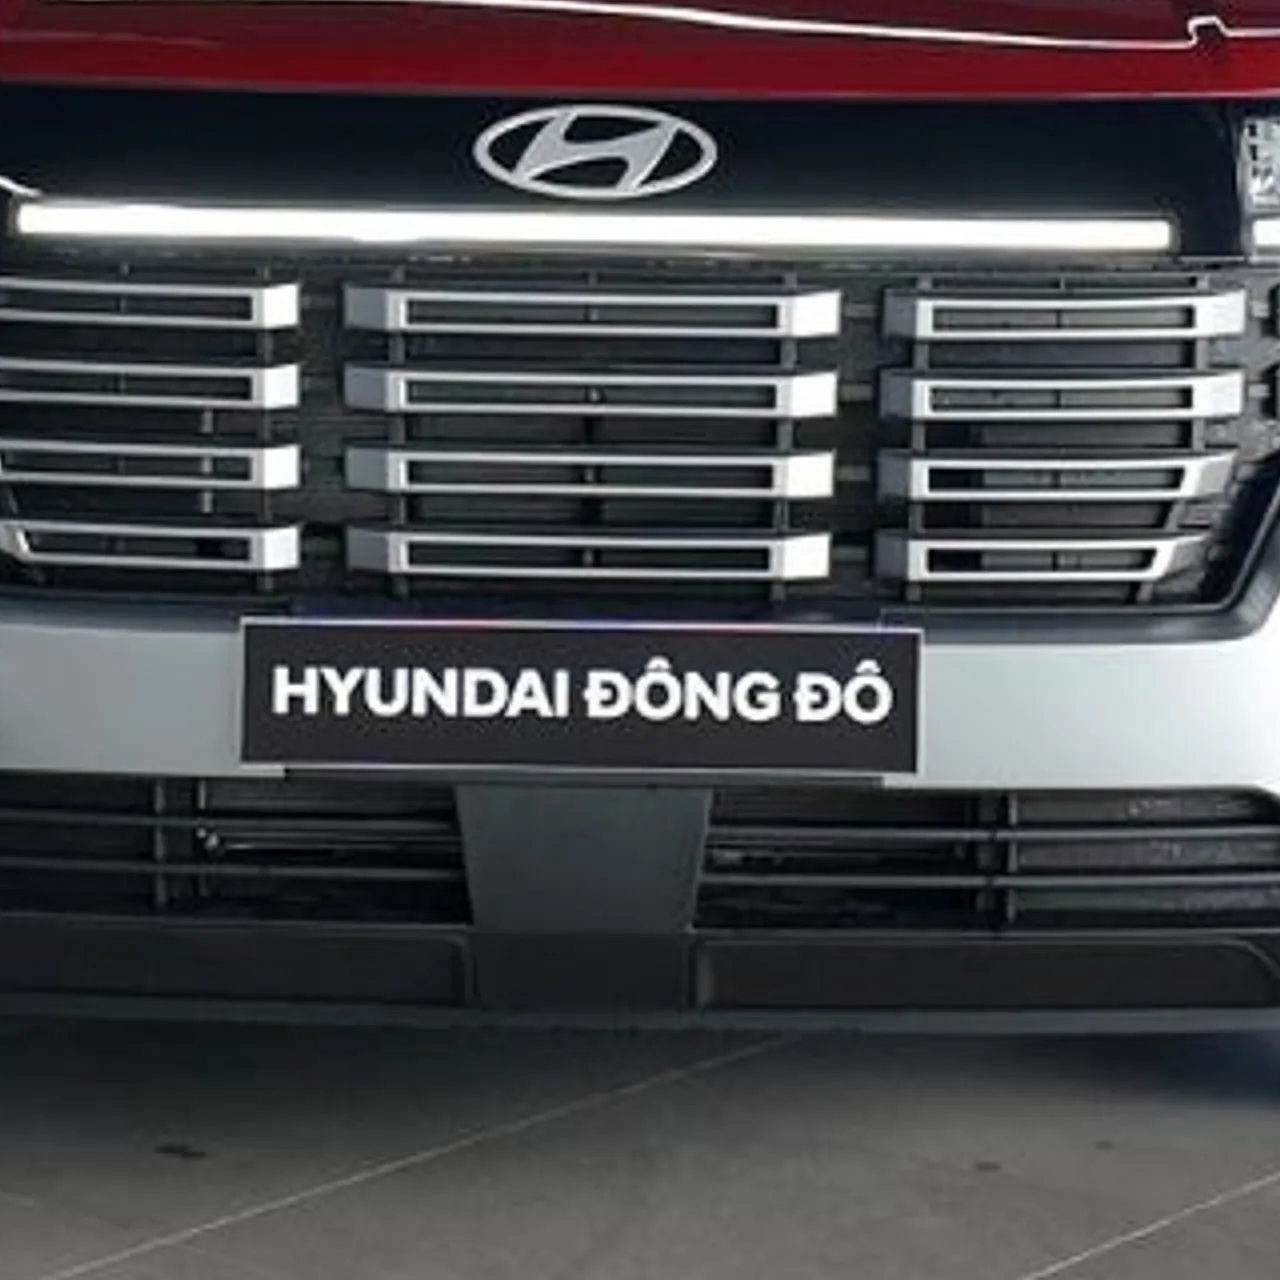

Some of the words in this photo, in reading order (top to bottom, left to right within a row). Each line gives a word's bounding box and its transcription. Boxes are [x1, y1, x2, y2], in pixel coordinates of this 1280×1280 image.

[272, 665, 570, 718] HYUNDAI
[582, 656, 781, 722] ĐÔNG
[792, 659, 893, 725] ĐÔ
